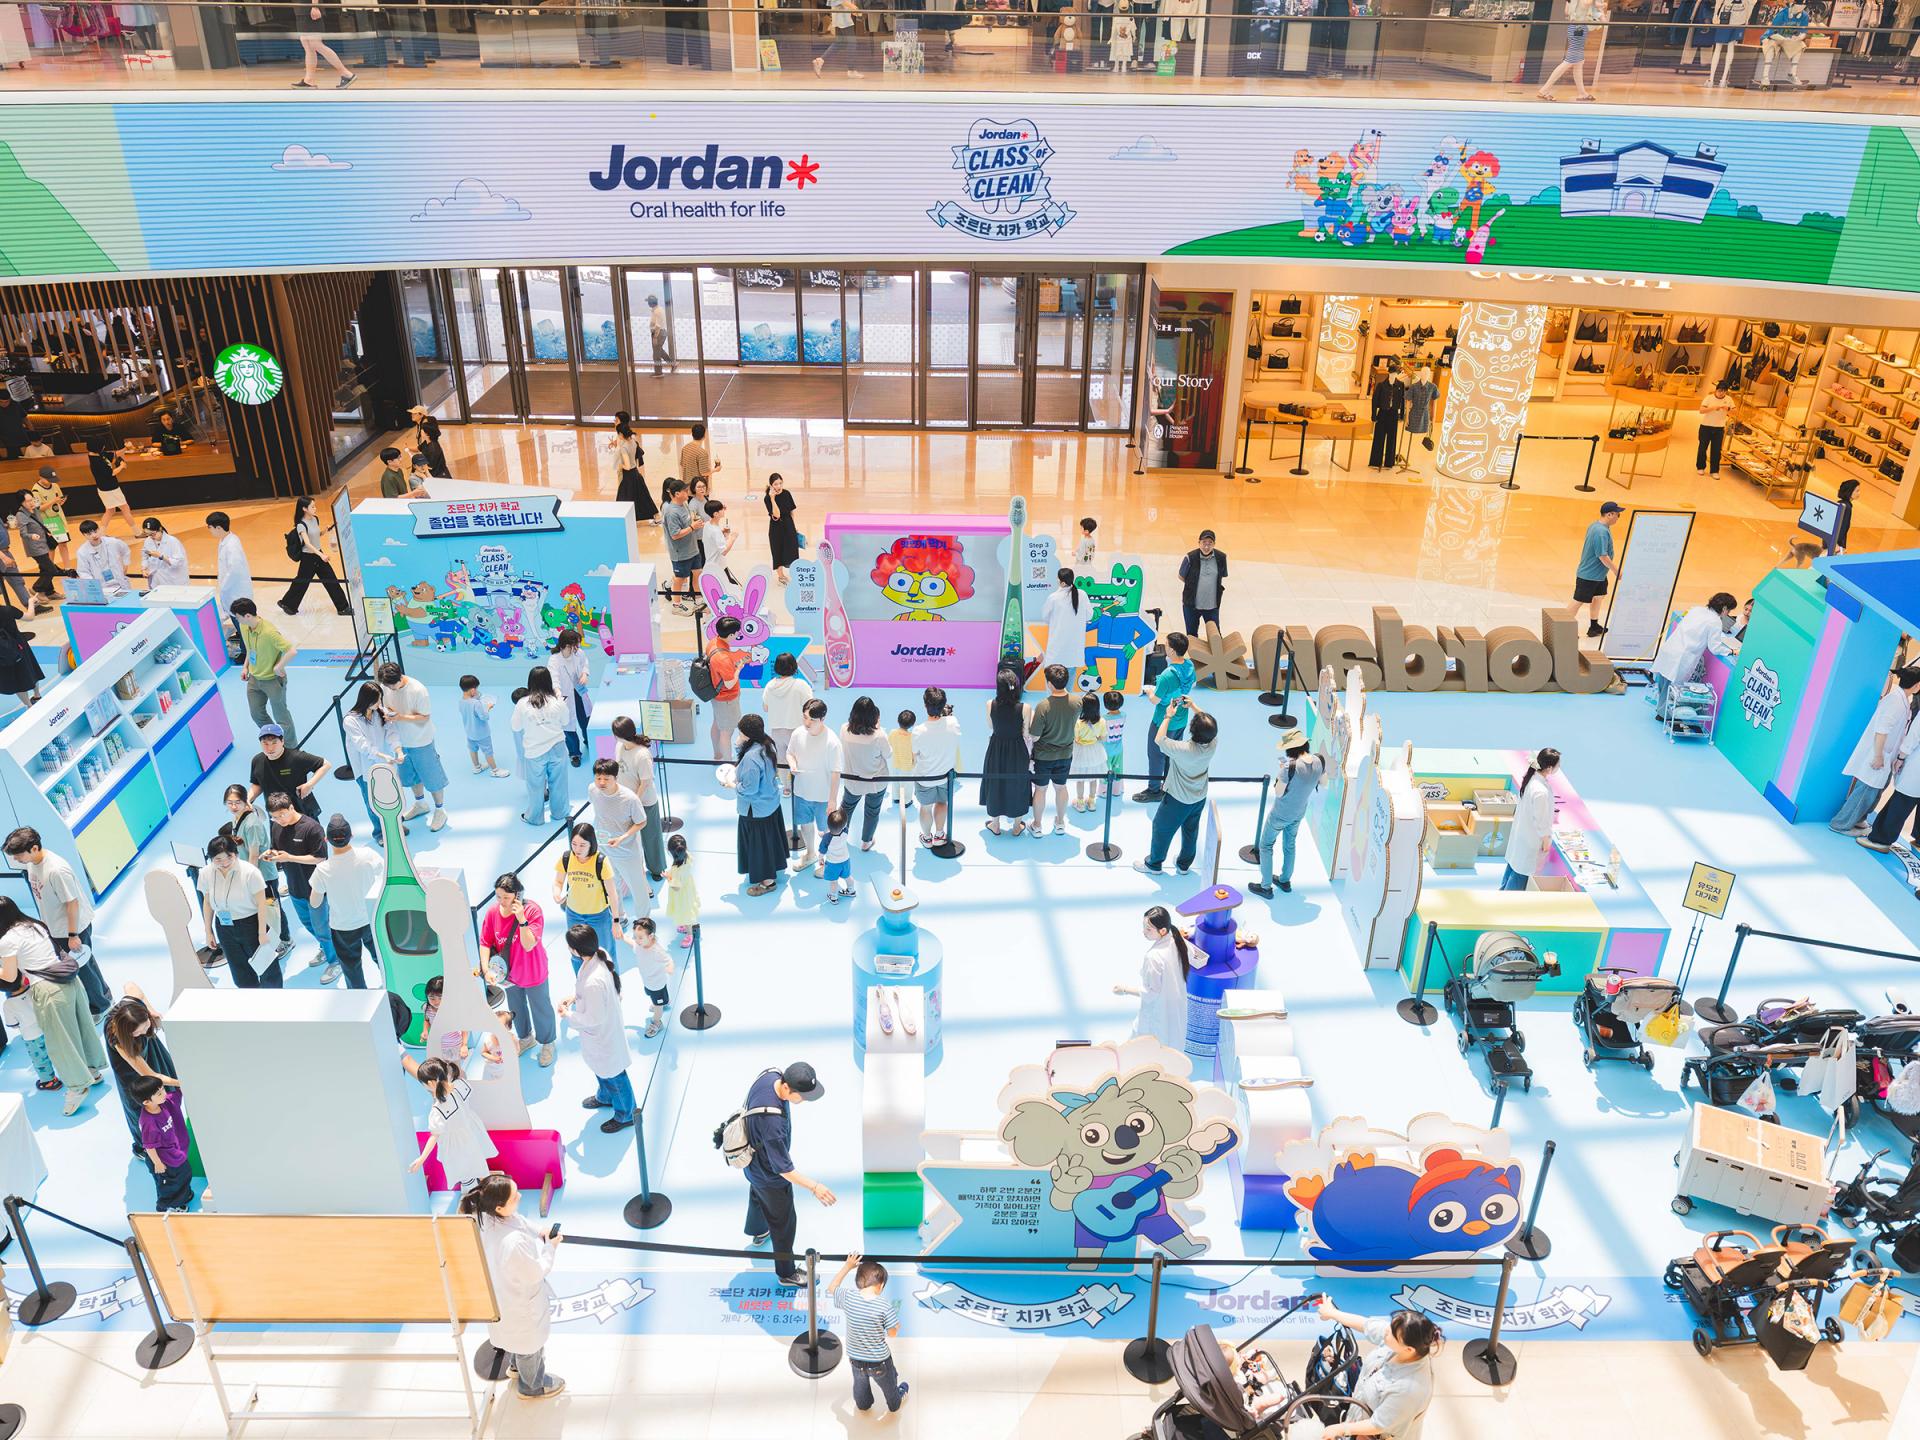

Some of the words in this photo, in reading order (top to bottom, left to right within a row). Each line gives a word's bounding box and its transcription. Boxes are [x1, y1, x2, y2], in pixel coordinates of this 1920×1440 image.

[979, 129, 1020, 140] Jordan
[969, 145, 1030, 171] CLASS
[1035, 148, 1048, 159] OF
[589, 144, 783, 190] Jordan
[973, 173, 1036, 199] CLEAN
[630, 202, 668, 218] Oral
[673, 201, 725, 218] health
[730, 201, 756, 218] for
[760, 200, 785, 217] life
[954, 212, 992, 235] 조르단
[996, 224, 1021, 236] 치카
[1024, 213, 1051, 231] 학교
[1178, 374, 1213, 390] Story
[447, 502, 476, 514] 조르단
[479, 502, 498, 512] 치카
[500, 501, 520, 511] 학교
[429, 515, 469, 530] 졸업을
[472, 511, 543, 528] 축하합니다!
[481, 554, 504, 563] CLASS
[1030, 550, 1047, 558] 6-9
[485, 563, 509, 572] CLEAN
[798, 574, 815, 582] 3-5
[131, 640, 146, 655] Jordan
[891, 644, 946, 656] Jordan
[1756, 666, 1772, 684] Jordan
[1747, 677, 1772, 701] CLASS
[1744, 696, 1770, 720] CLEAN
[49, 708, 66, 727] Jordan
[1698, 881, 1721, 894] 유모차
[1695, 890, 1718, 903] 대기존
[79, 1290, 118, 1309] 학교
[709, 1287, 744, 1297] 조르단
[748, 1288, 771, 1297] 치카
[1197, 1289, 1309, 1310] Jordan
[571, 1294, 609, 1312] 학교
[738, 1300, 772, 1310] 새로운
[954, 1295, 1008, 1322] 조르단
[1016, 1310, 1051, 1323] 치카
[1057, 1298, 1093, 1317] 학교
[744, 1314, 765, 1324] 기간
[772, 1314, 806, 1324] 6.3(수)
[1222, 1315, 1244, 1324] Oral
[1299, 1314, 1315, 1324] life
[1435, 1298, 1491, 1324] 조르단
[1502, 1311, 1536, 1326] 치카
[1538, 1300, 1573, 1320] 학교
